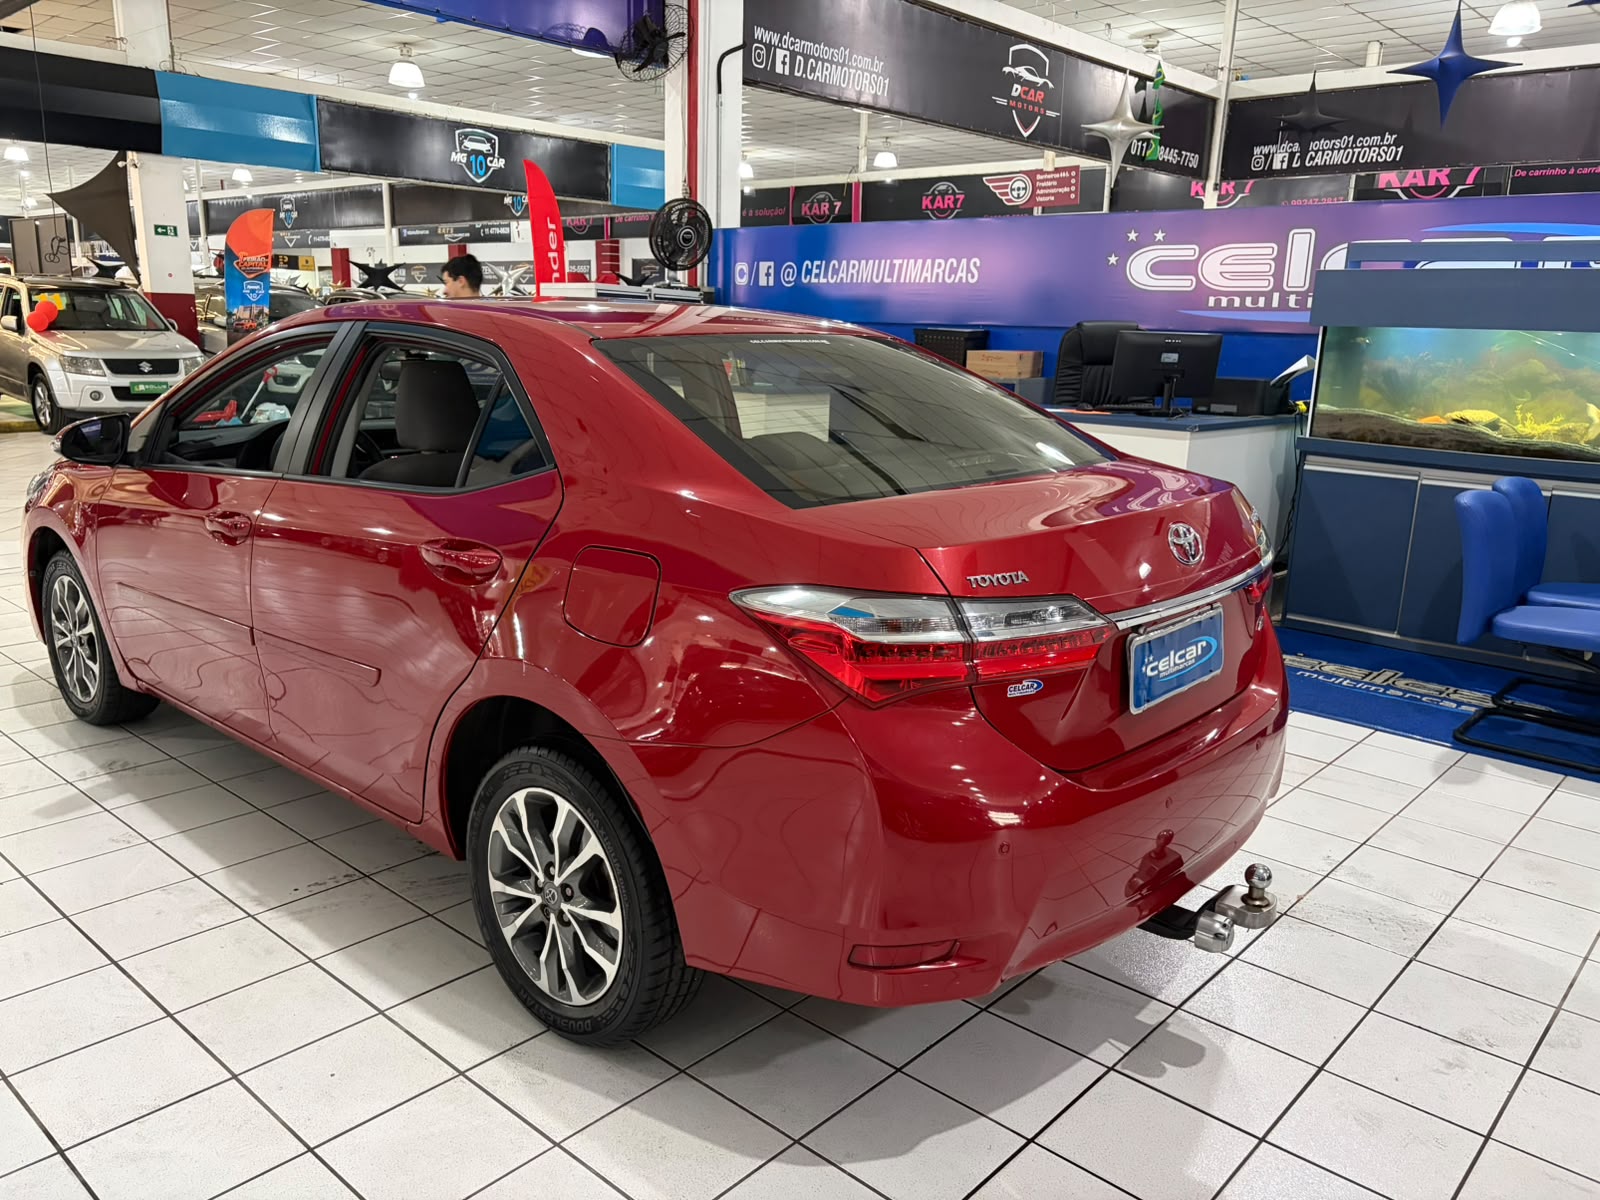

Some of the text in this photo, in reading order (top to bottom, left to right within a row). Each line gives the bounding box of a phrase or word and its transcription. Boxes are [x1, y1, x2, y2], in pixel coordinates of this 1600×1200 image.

[754, 25, 883, 73] www.dcarmotors01.com.br
[794, 55, 889, 97] D.CARMOTORS01
[1011, 83, 1045, 103] DCAR
[1009, 100, 1045, 115] MOTORS
[450, 151, 468, 163] MG
[470, 154, 486, 176] 10
[487, 157, 506, 168] CAR
[1514, 169, 1526, 178] De
[1528, 168, 1567, 177] carrinho
[801, 201, 842, 216] KAR 7
[801, 257, 980, 285] CELCARMULTIMARCAS
[967, 570, 1029, 589] TOYOTA
[1146, 640, 1207, 677] celcar
[1009, 683, 1035, 693] CELCAR
